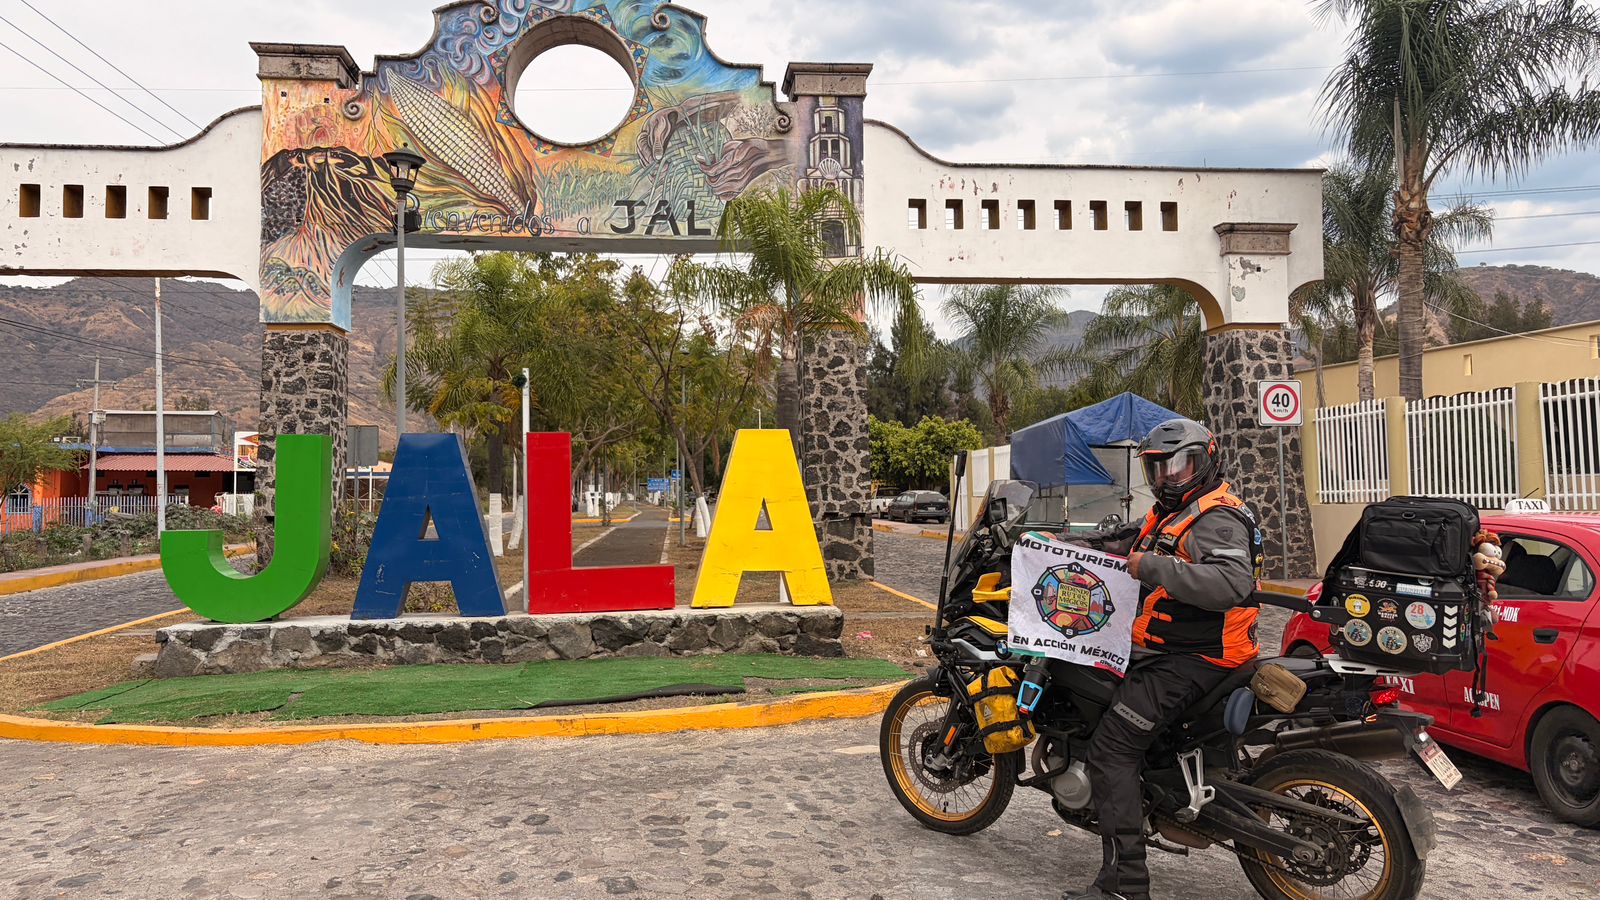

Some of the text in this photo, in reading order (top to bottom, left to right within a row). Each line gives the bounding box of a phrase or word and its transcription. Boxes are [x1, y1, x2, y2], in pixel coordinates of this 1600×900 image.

[577, 215, 592, 236] a
[610, 200, 728, 237] JAL
[1271, 392, 1290, 408] 40
[1515, 500, 1544, 510] TAXI
[160, 428, 834, 624] JALA
[1015, 538, 1130, 573] MOTOTURISM
[1410, 603, 1425, 615] 28
[1012, 635, 1126, 665] EN ACCIÓN MÉXICO
[1385, 675, 1416, 695] TAXI
